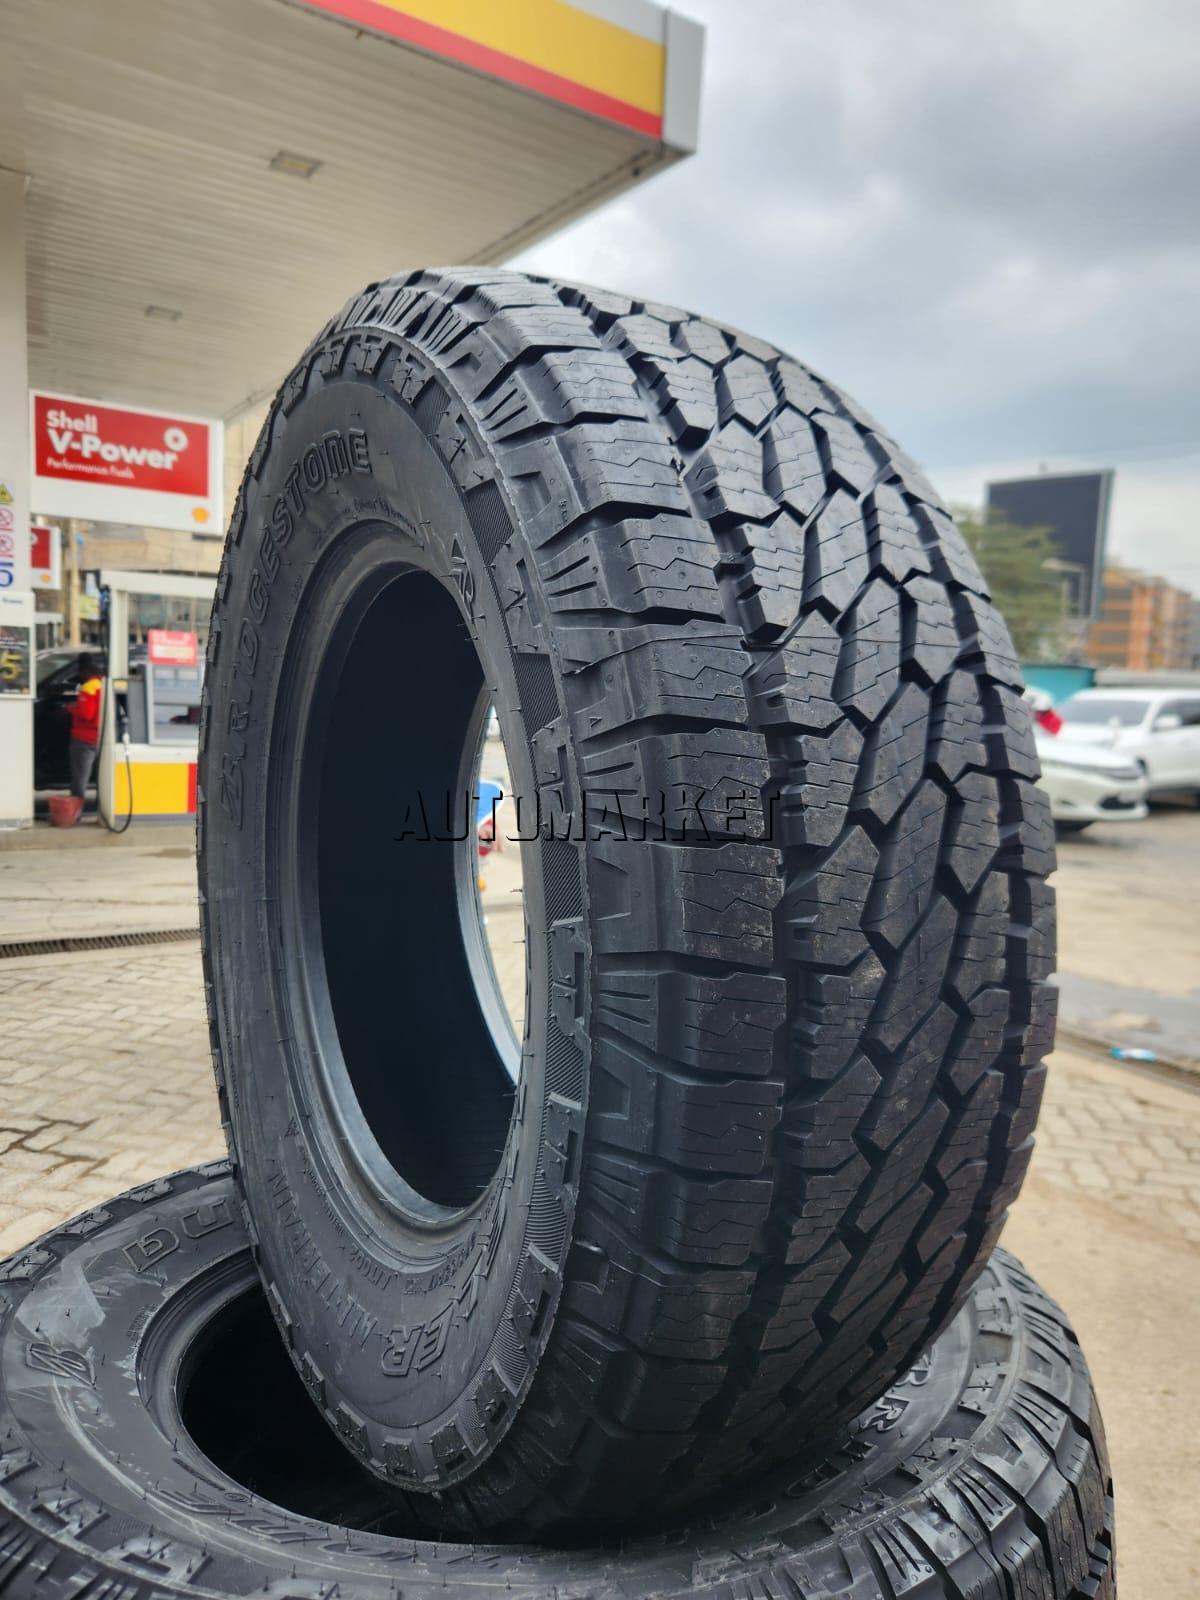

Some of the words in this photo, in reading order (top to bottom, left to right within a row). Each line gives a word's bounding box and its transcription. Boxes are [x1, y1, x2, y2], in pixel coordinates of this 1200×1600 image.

[46, 409, 98, 434] Shell
[47, 427, 178, 471] V-Power
[218, 427, 374, 830] BRIDGESTONE
